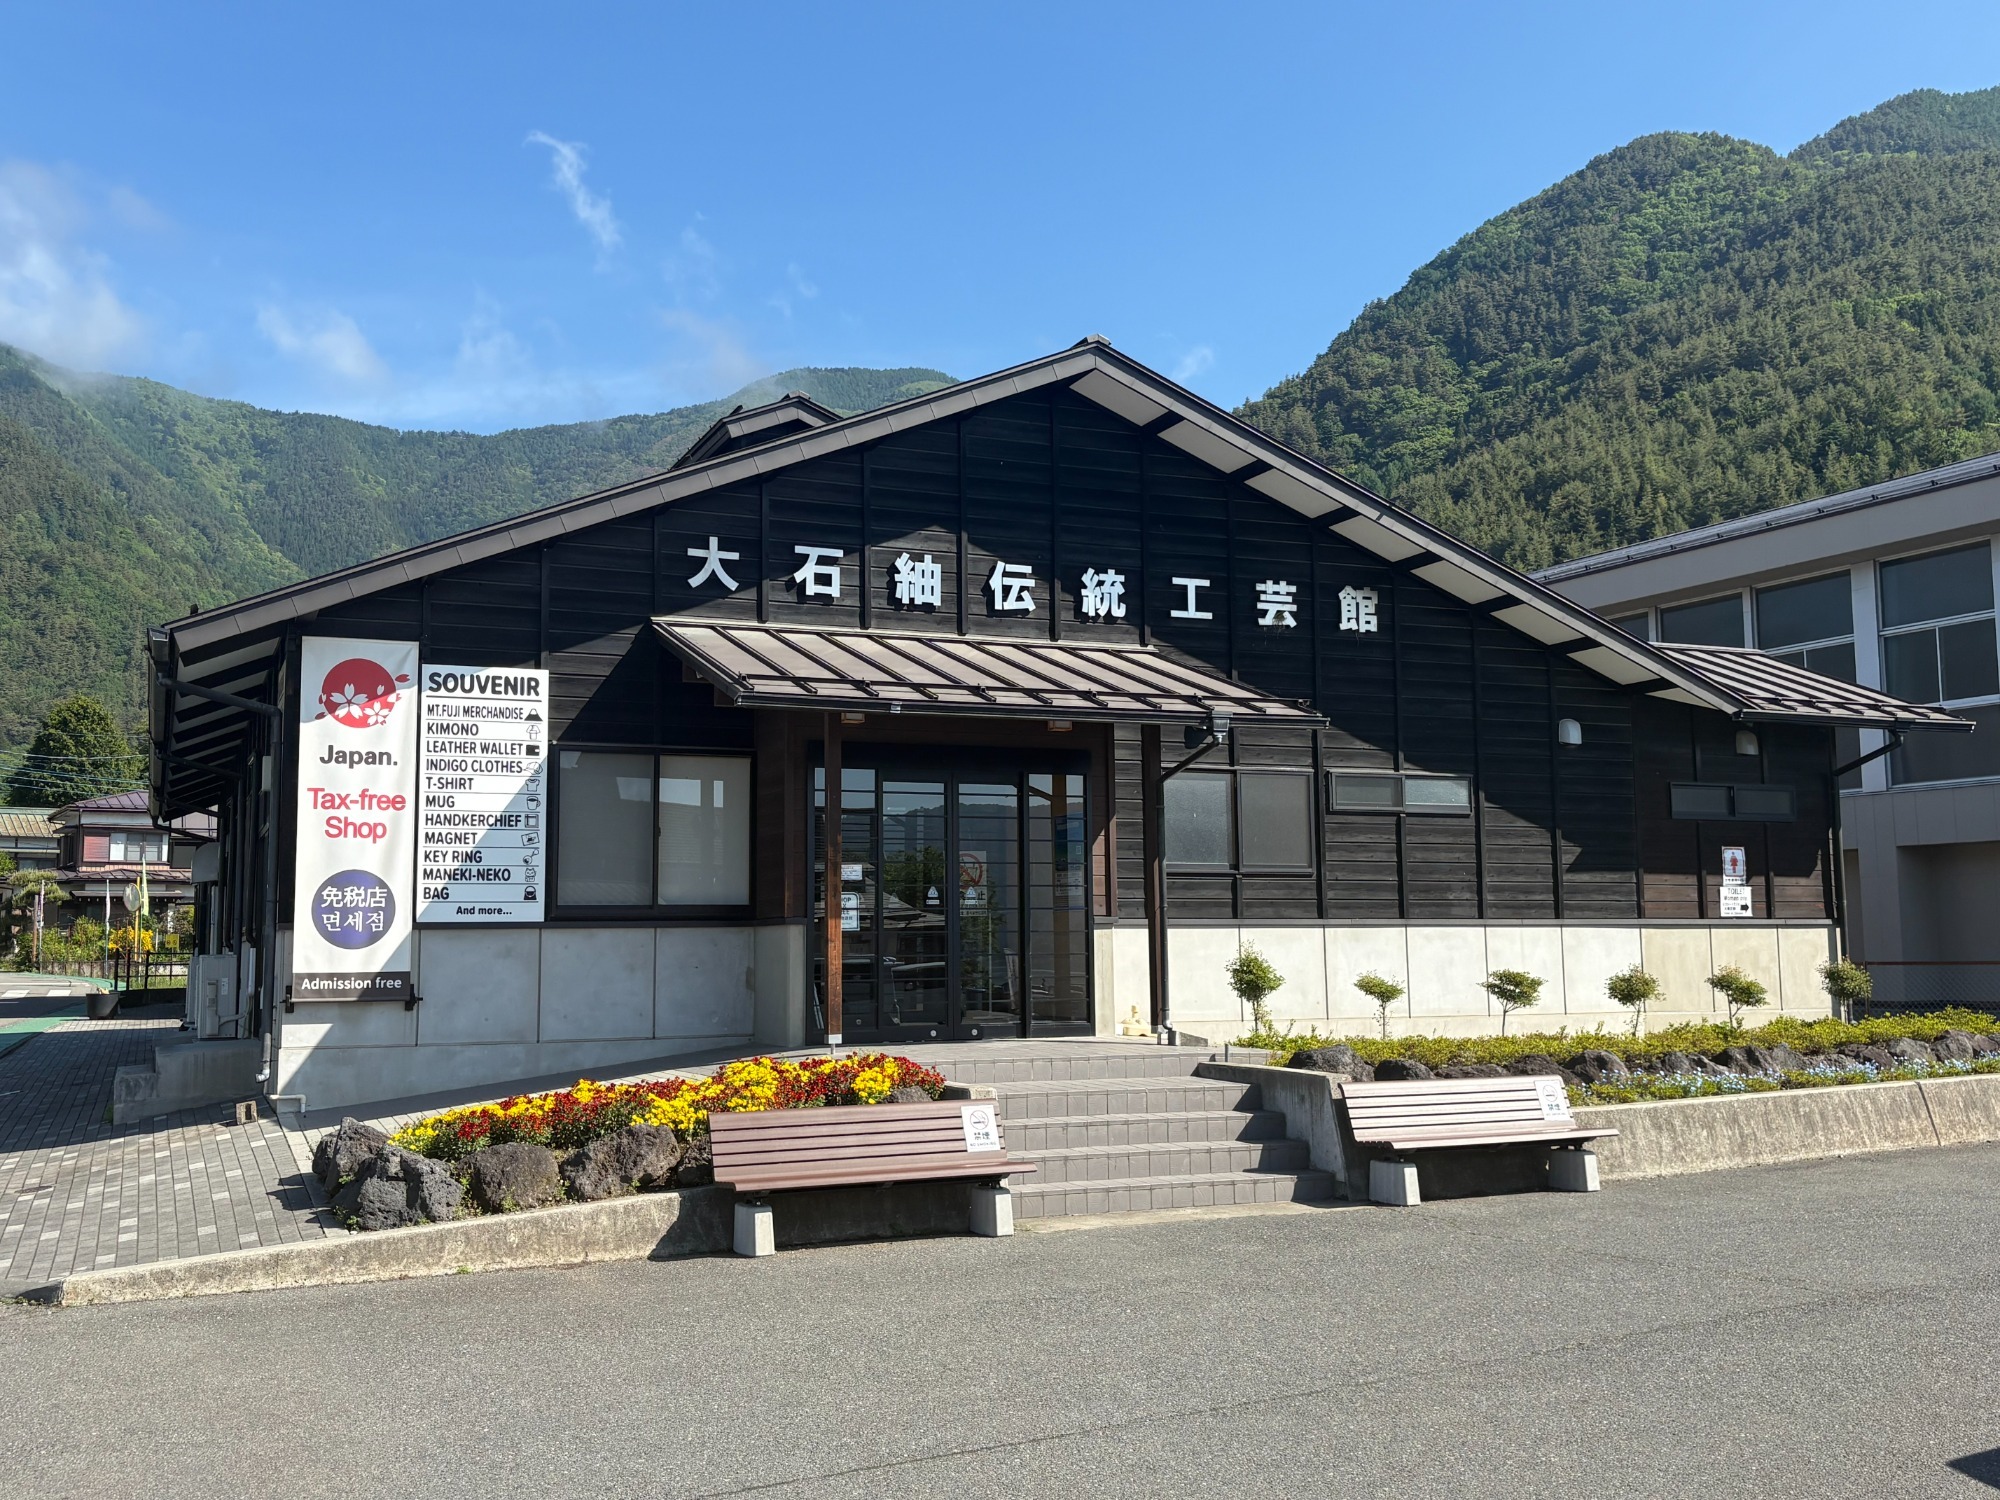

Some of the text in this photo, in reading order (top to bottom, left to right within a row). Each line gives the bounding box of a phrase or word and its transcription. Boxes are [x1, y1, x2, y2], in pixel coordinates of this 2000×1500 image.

[687, 536, 1379, 633] 大石紬伝統工芸館
[428, 672, 540, 697] SOUVENIR
[427, 704, 524, 720] MT.FUJI MERCHANDISE
[427, 722, 479, 736] KIMONO
[426, 740, 523, 756] LEATHER WALLET
[319, 744, 398, 769] Japan.
[426, 758, 523, 774] INDIGO CLOTHES
[426, 776, 474, 791] T-SHIRT
[307, 787, 406, 811] Tax-free
[425, 795, 455, 808] MUG
[425, 813, 522, 828] HANDKERCHIEF
[324, 816, 387, 843] Shop
[424, 832, 477, 845] MAGNET
[424, 850, 483, 864] KEY RING
[423, 868, 511, 882] MANEKI-NEKO
[320, 886, 388, 908] 免税店
[423, 886, 450, 900] BAG
[456, 905, 513, 916] And more...
[322, 911, 385, 932] 면세점
[301, 977, 402, 990] Admission free
